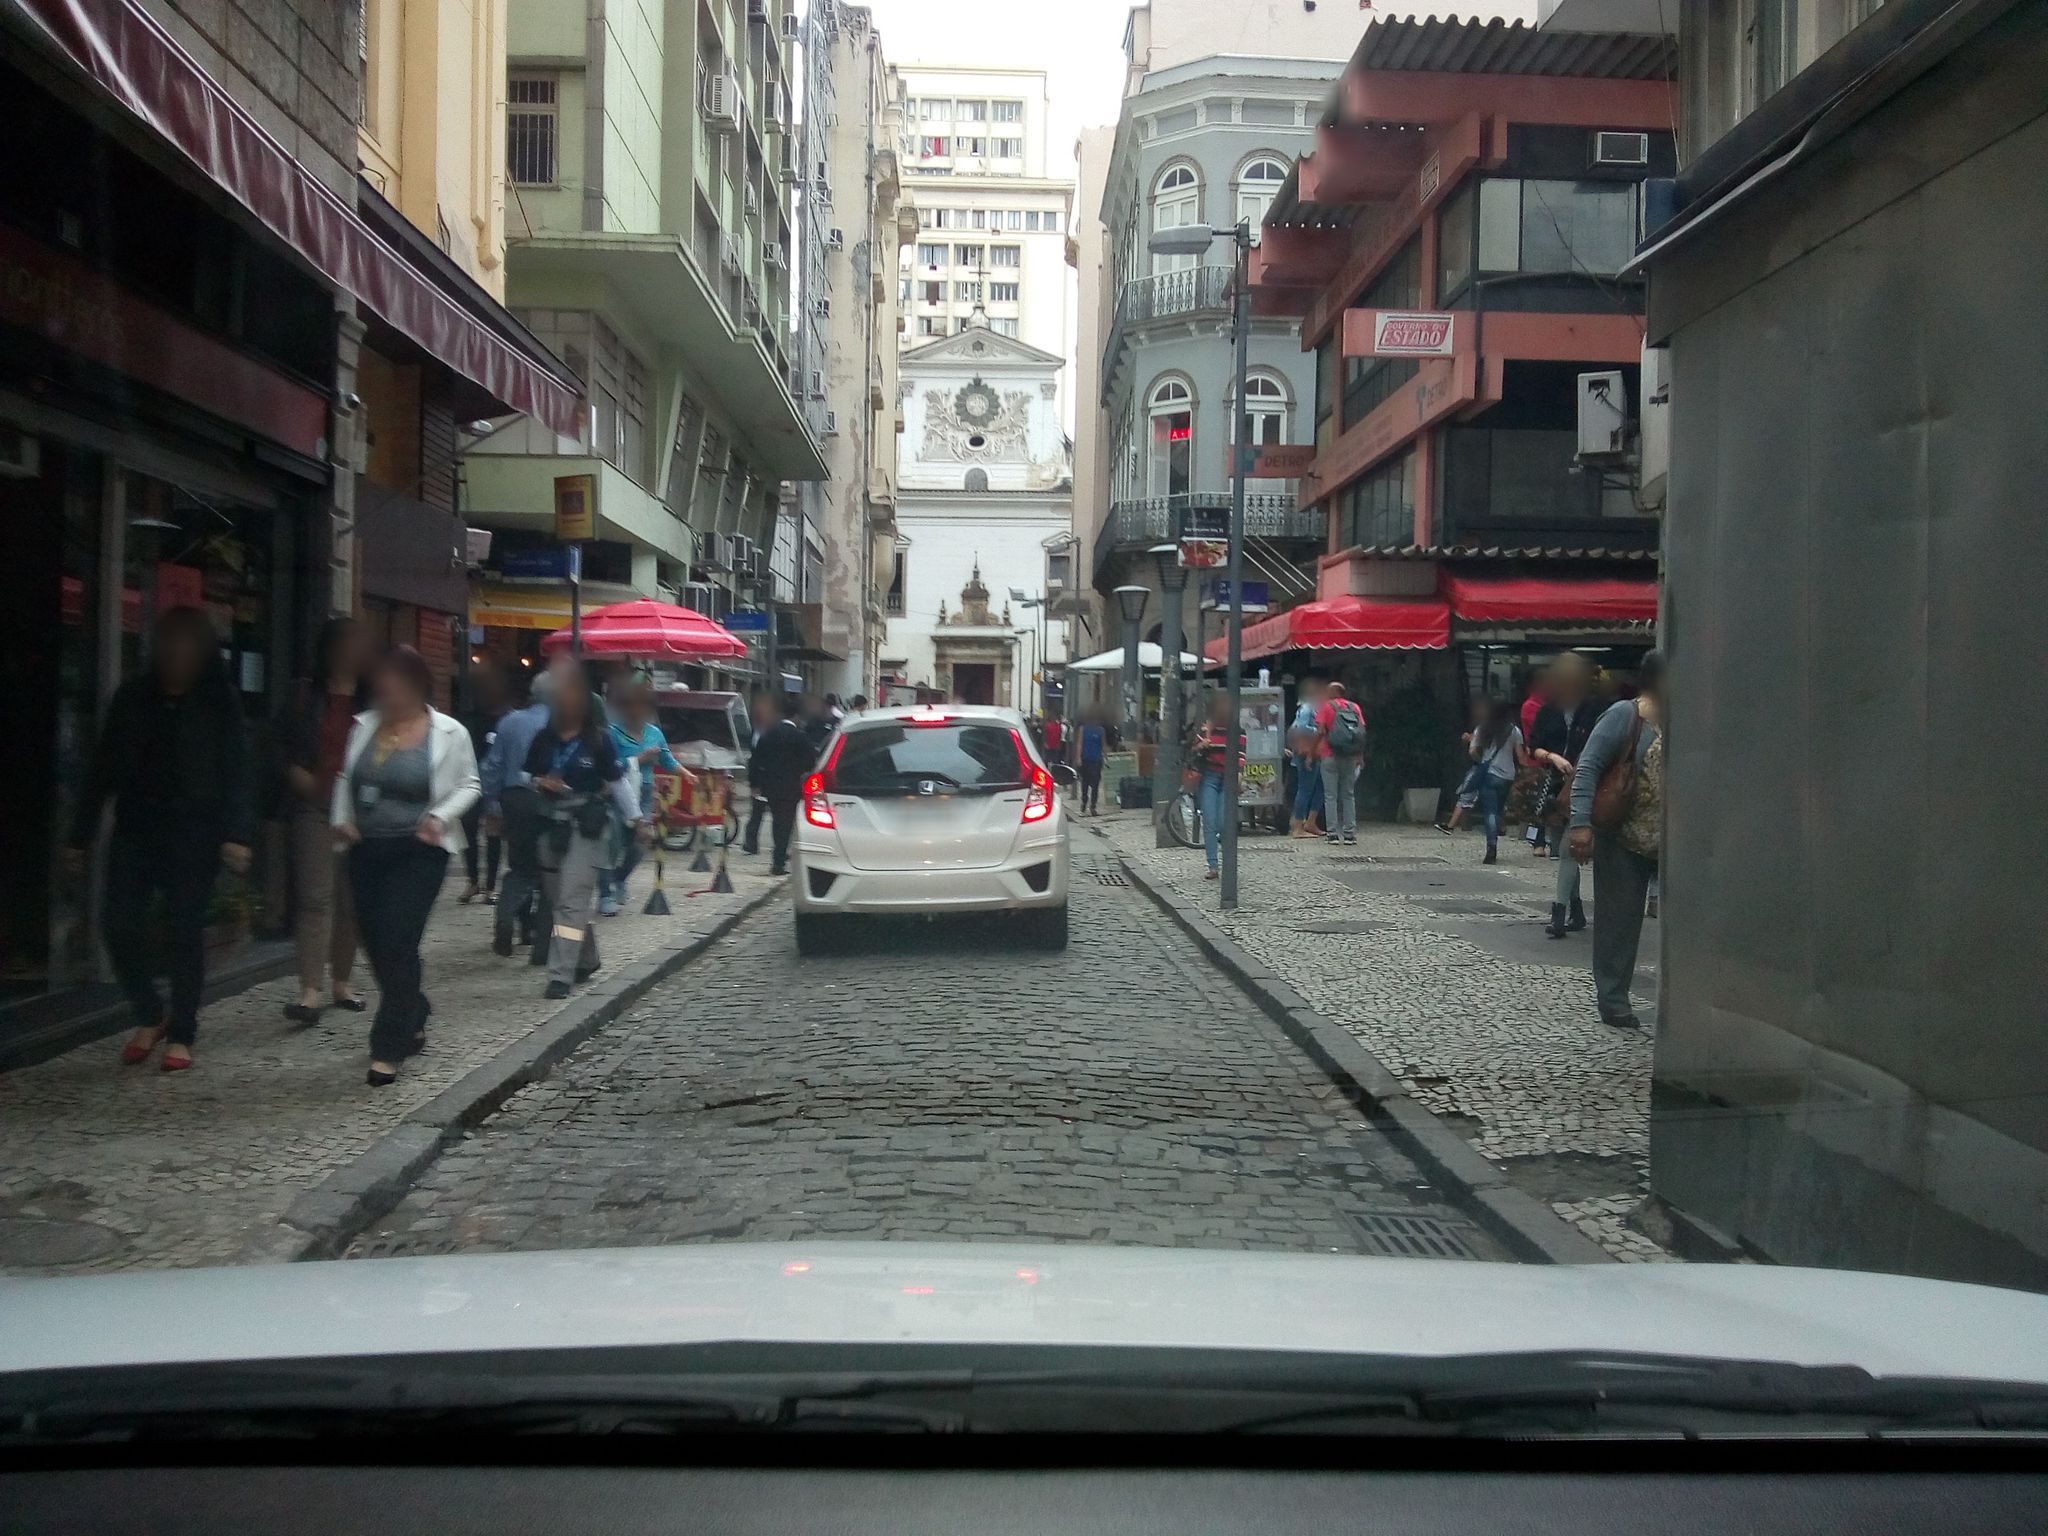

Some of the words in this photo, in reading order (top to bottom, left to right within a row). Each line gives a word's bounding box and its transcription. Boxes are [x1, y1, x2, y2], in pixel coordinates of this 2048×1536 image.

[1386, 322, 1428, 331] GOVERNO
[1381, 330, 1441, 346] ESTADO
[1264, 454, 1304, 468] DETRO
